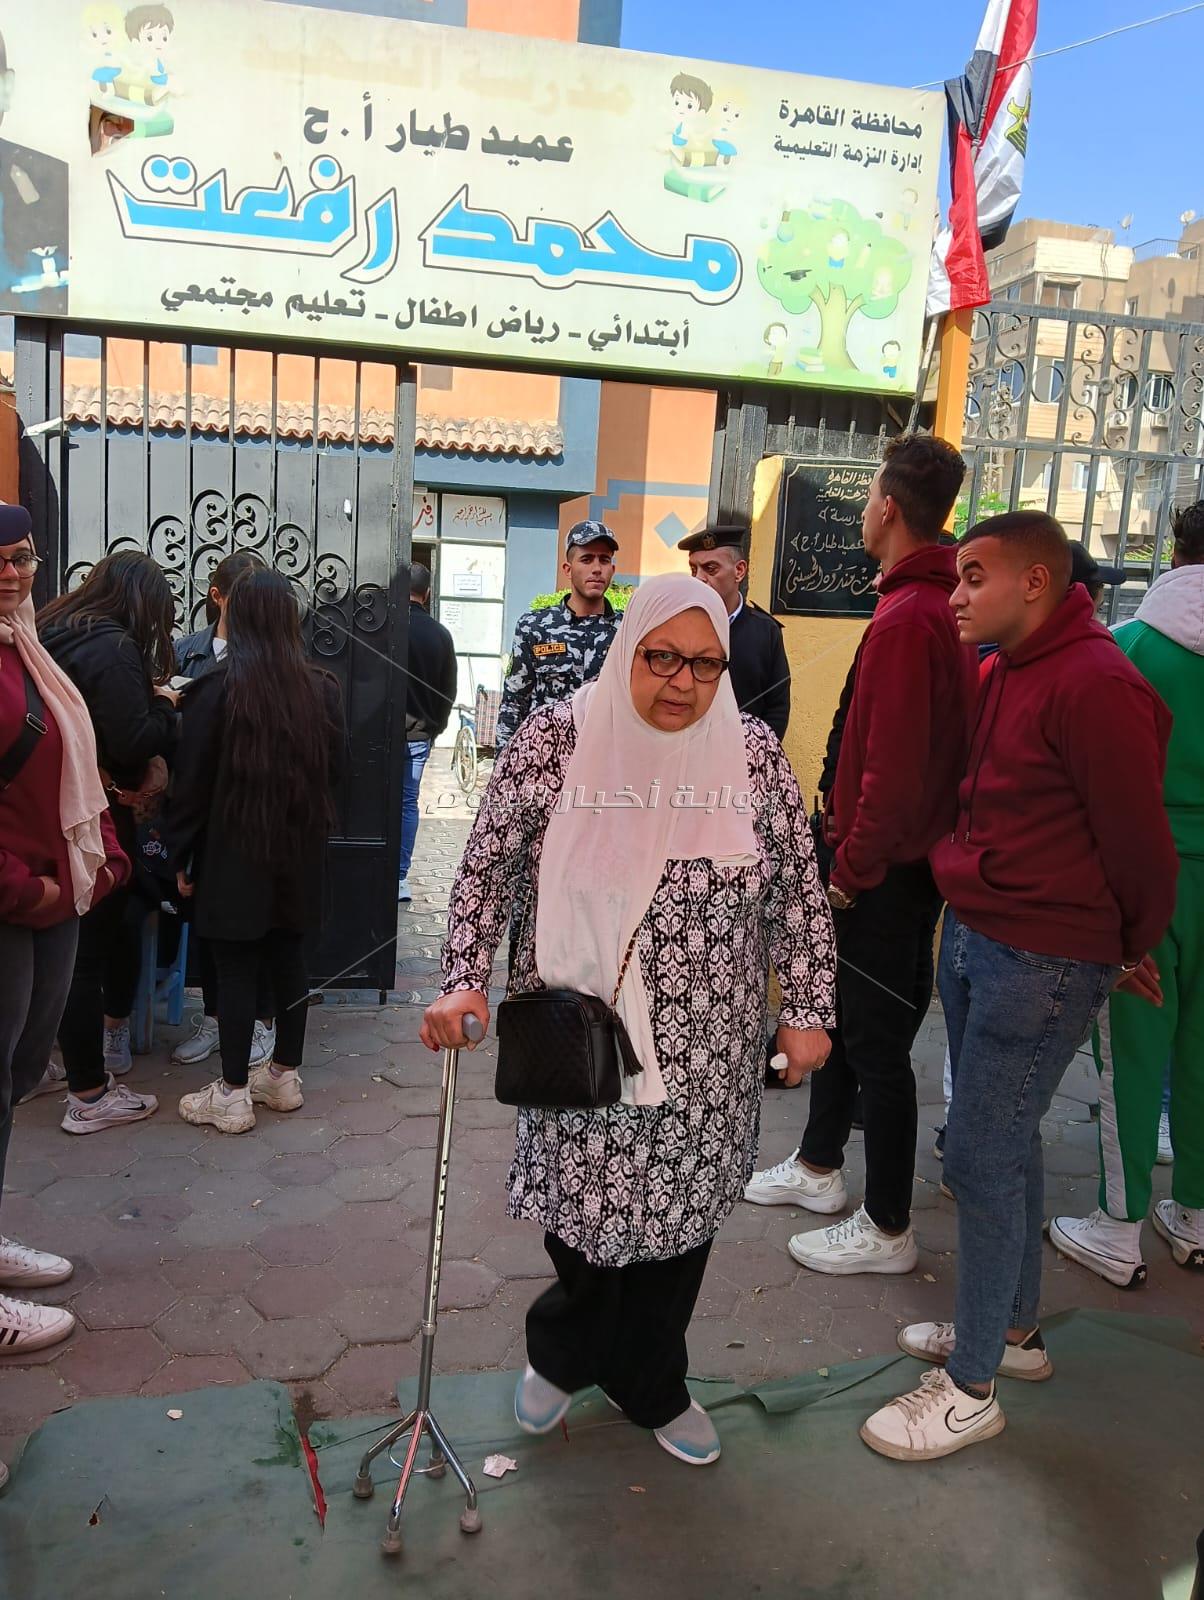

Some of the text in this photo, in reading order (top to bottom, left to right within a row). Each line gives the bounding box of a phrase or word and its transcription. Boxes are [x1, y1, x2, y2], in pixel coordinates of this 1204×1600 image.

[385, 108, 470, 156] طيار
[778, 99, 922, 139] محافظة القاهرة
[481, 125, 574, 167] عميد
[773, 134, 922, 174] إدارة النزهة التعليمية
[106, 154, 743, 306] محمد رفعت
[160, 276, 274, 315] مجتمعي
[285, 288, 366, 322] تعليم
[394, 297, 478, 330] اطفال
[486, 305, 560, 344] رياض
[825, 468, 857, 486] القاهرة
[830, 507, 863, 526] درسة
[815, 533, 837, 553] طيار
[534, 643, 565, 655] POLICE
